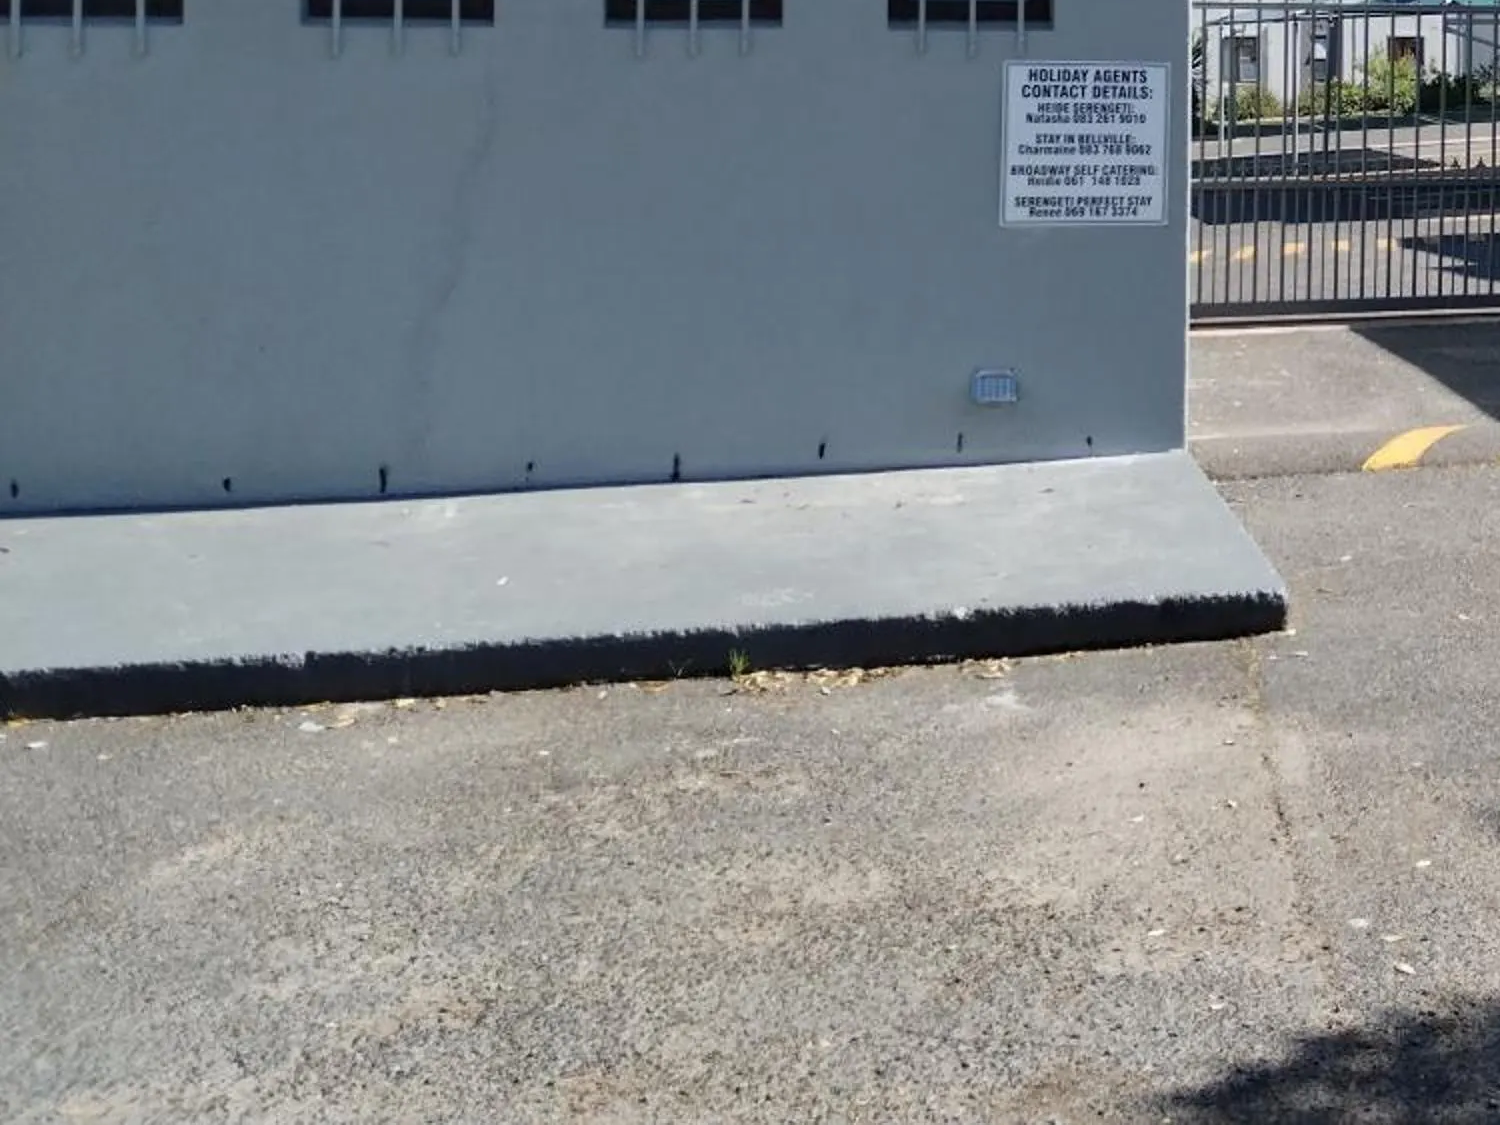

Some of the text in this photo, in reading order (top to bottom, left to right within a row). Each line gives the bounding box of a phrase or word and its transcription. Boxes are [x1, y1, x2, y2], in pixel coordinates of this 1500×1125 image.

[1028, 69, 1147, 83] HOLIDAY AGENTS
[1021, 85, 1153, 99] CONTACT DETAILS:
[1026, 113, 1070, 123] Natasha
[1035, 134, 1060, 144] STAY
[1063, 134, 1074, 144] IN
[1018, 144, 1076, 155] Charmaine
[1010, 165, 1071, 175] BROADWAY
[1074, 165, 1100, 175] SELF
[1014, 196, 1152, 207] SERENGETI PERFECT STAY
